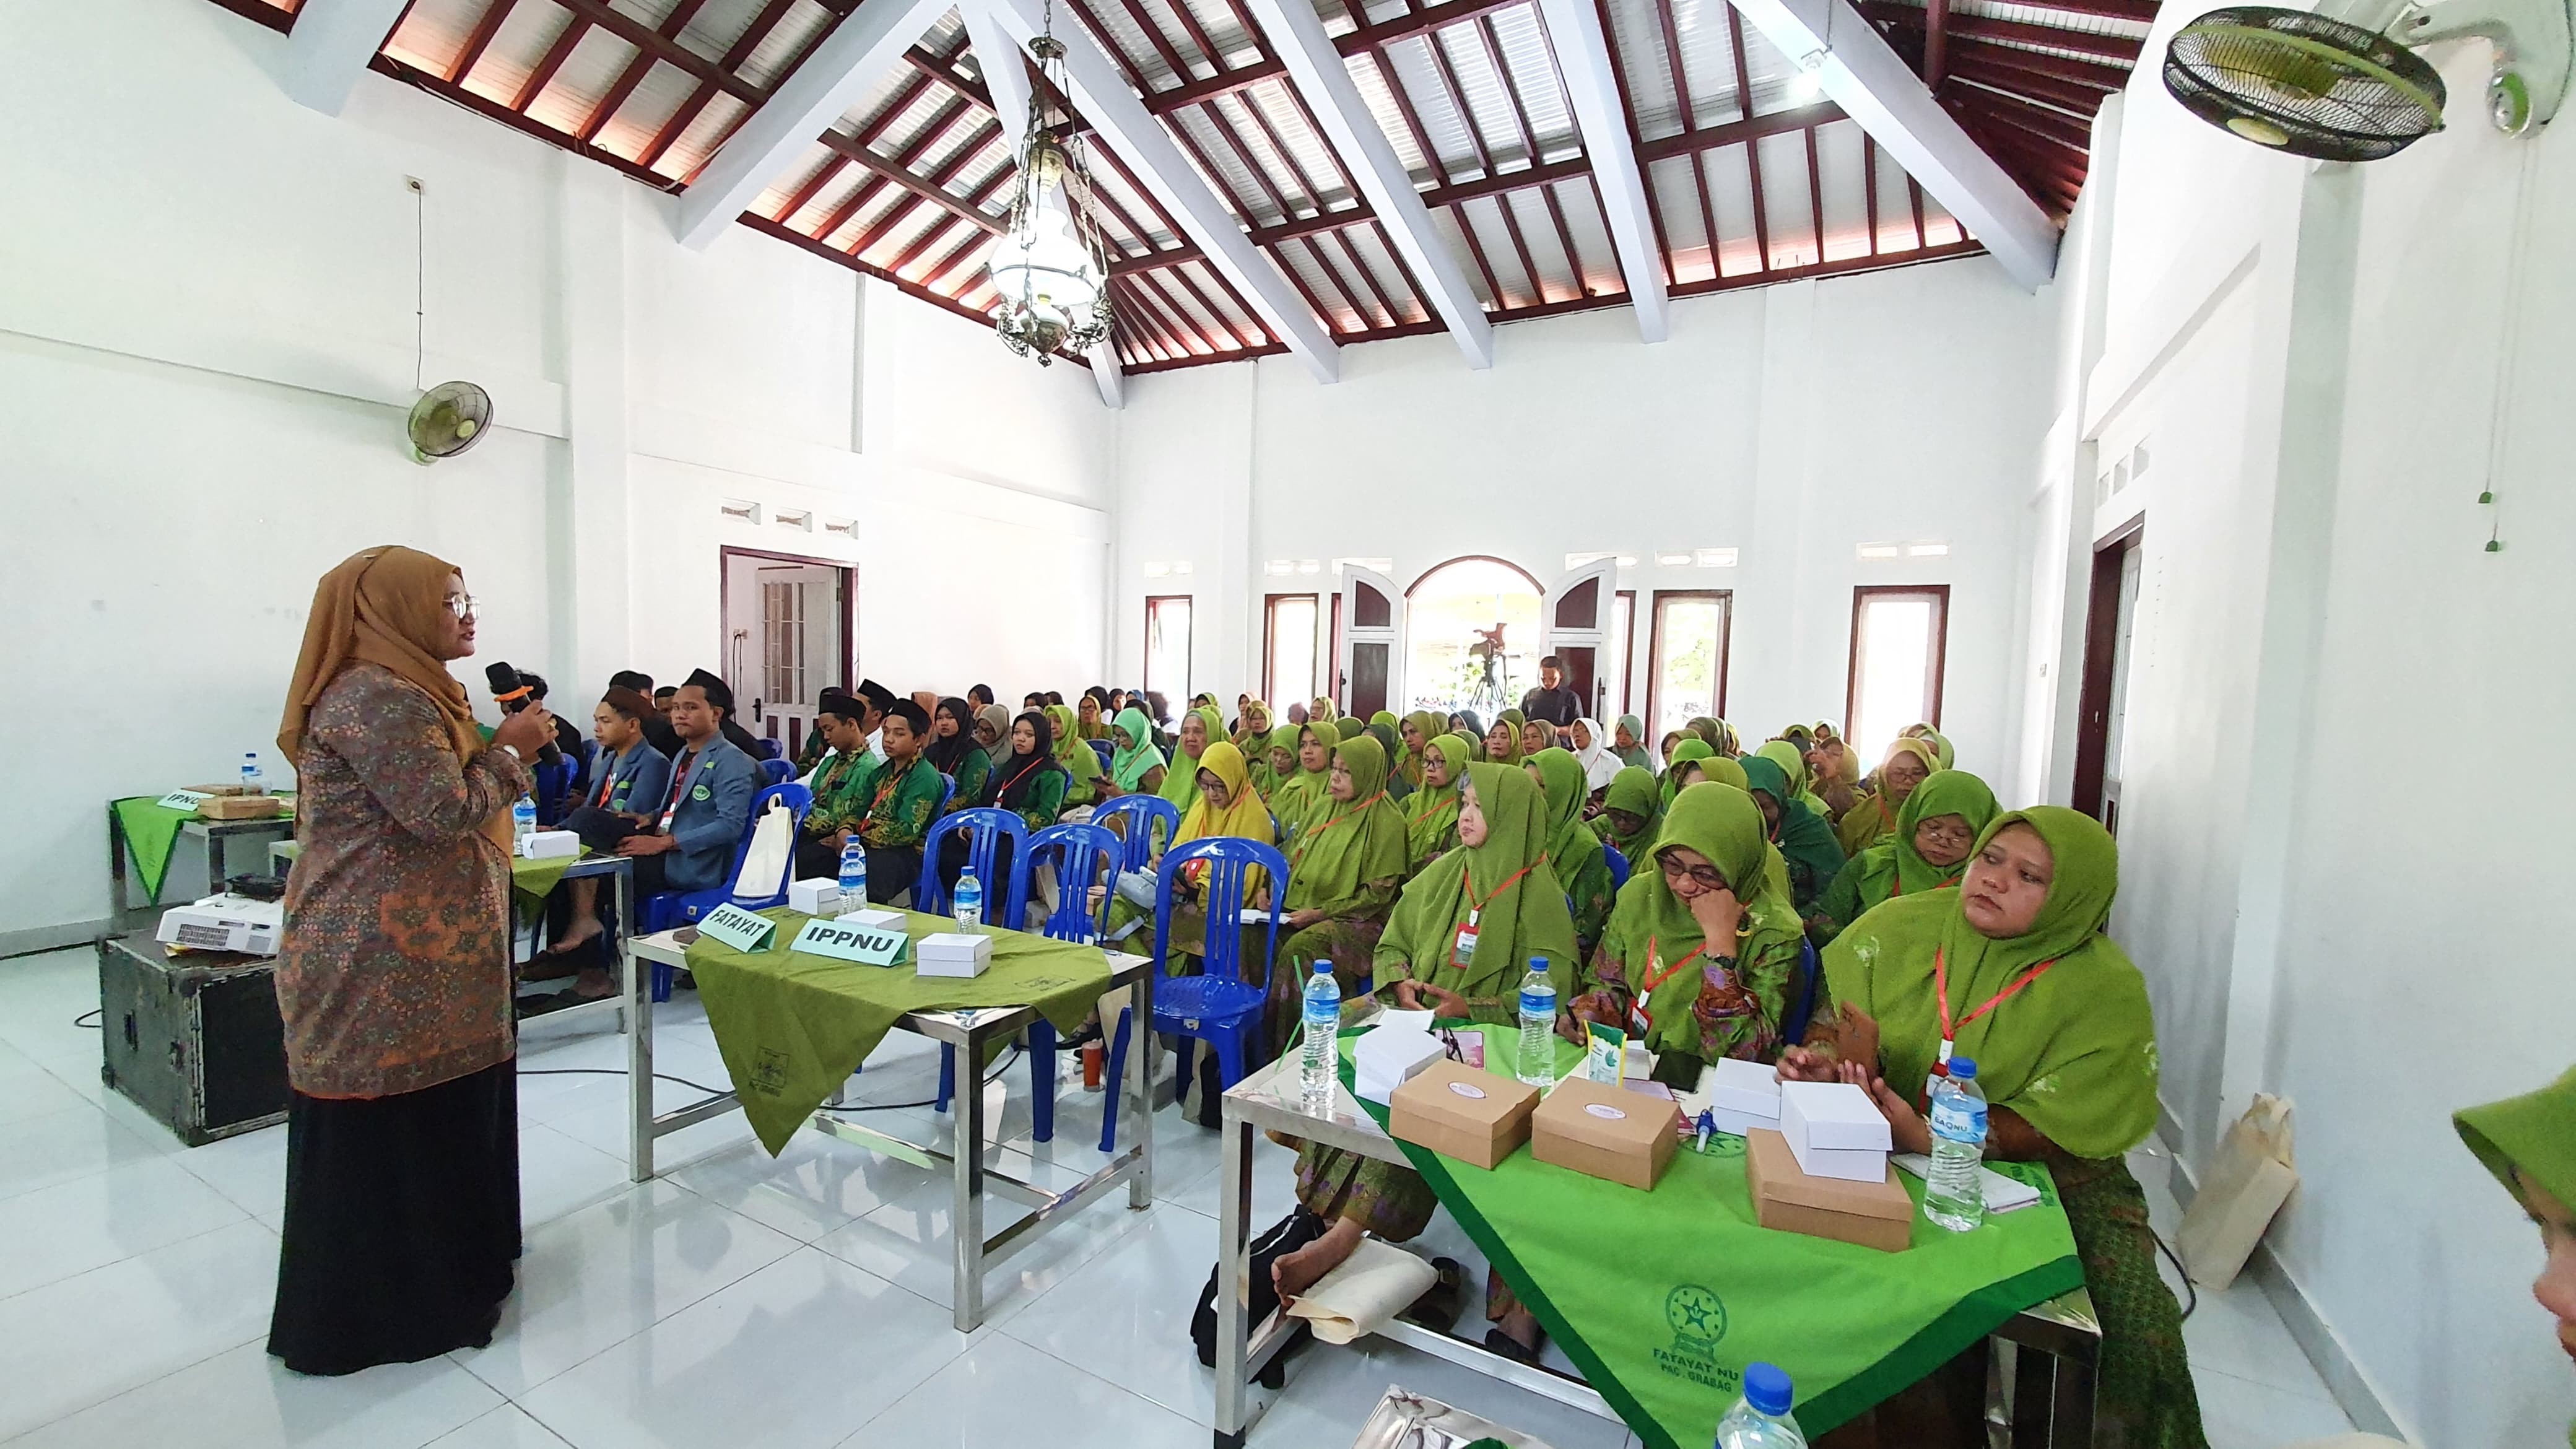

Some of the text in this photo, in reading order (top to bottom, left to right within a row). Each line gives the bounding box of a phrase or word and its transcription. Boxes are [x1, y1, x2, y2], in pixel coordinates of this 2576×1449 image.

[709, 909, 765, 937] FATAYAT
[806, 926, 894, 952] IPPNU
[1653, 1347, 1739, 1381] FATAYAT NU
[1687, 1371, 1732, 1392] GRABAG
